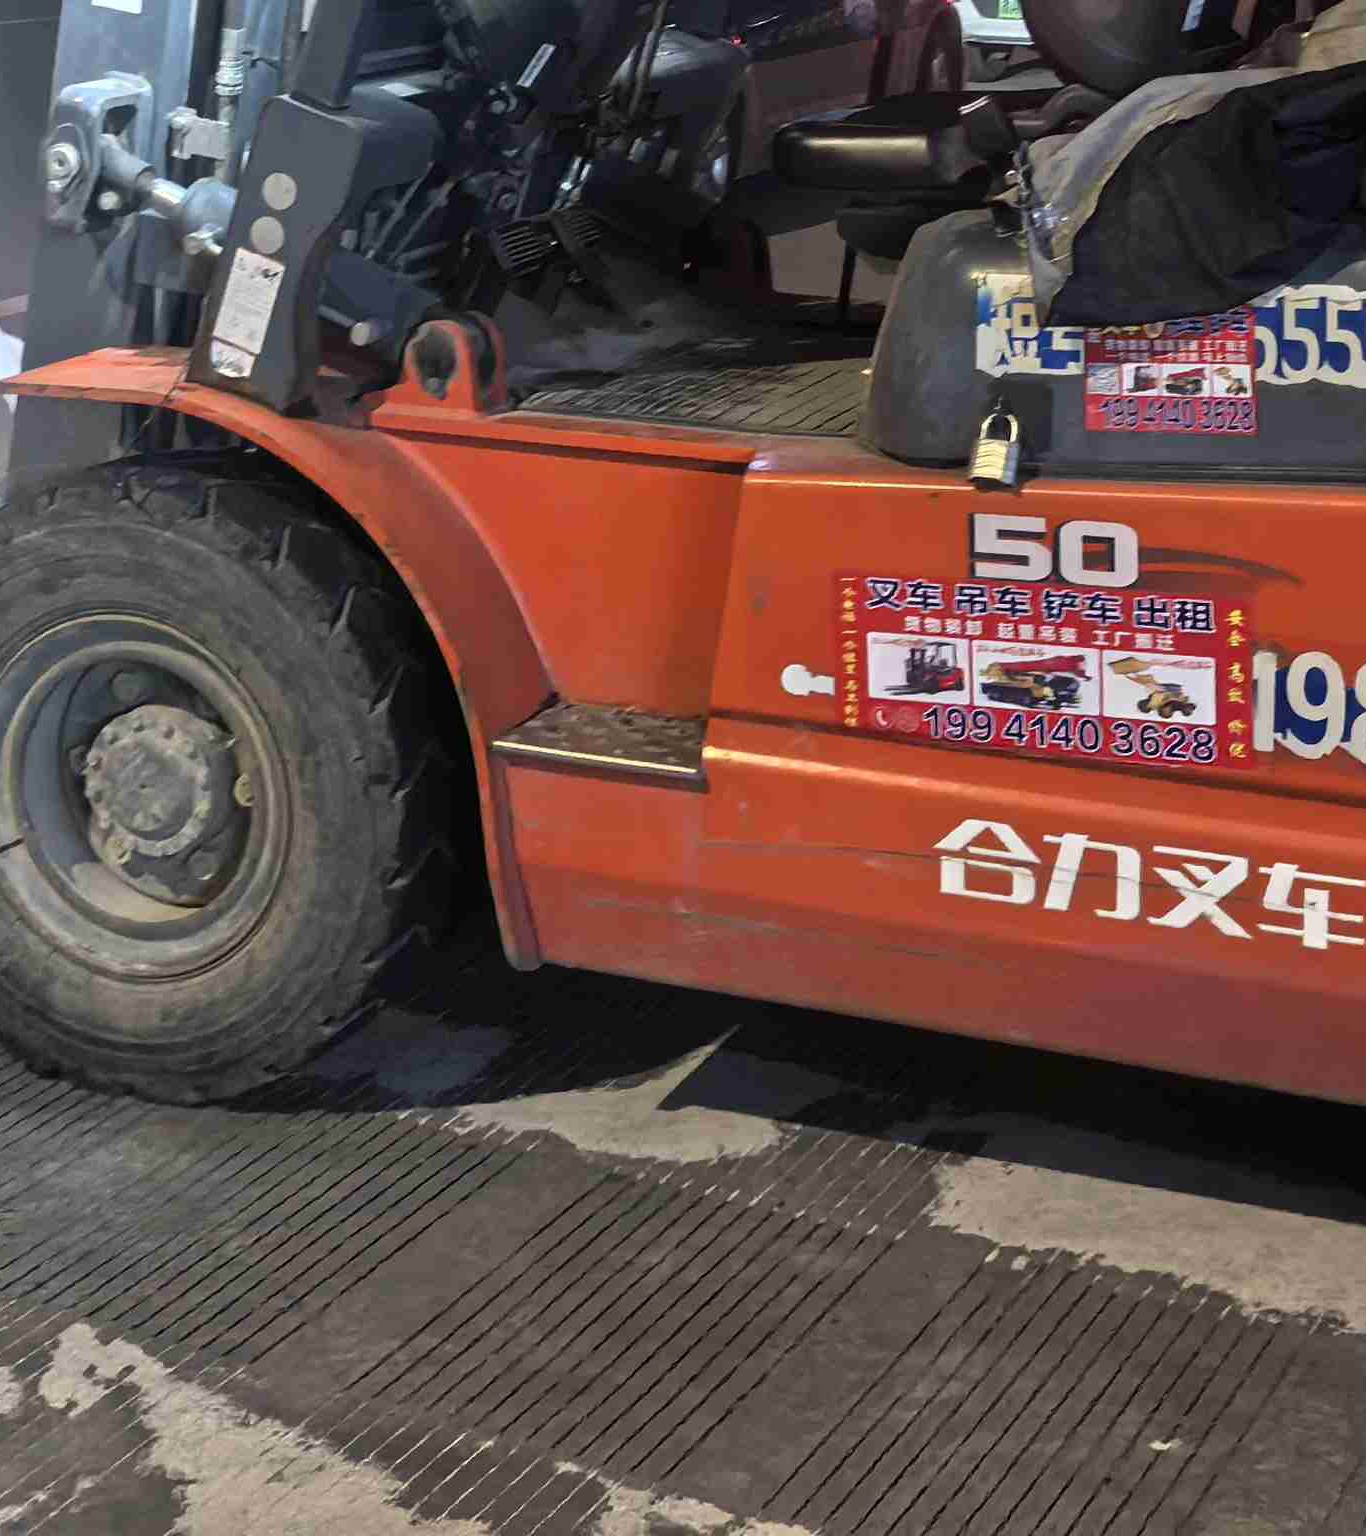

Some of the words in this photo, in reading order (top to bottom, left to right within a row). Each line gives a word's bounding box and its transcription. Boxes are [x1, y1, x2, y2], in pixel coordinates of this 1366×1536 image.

[970, 512, 1141, 588] 50
[864, 576, 945, 613] 叉车
[953, 582, 1035, 620] 吊车
[1041, 587, 1125, 626] 铲车
[1132, 595, 1217, 634] 出租
[1224, 609, 1247, 648] 安全
[922, 704, 996, 744] 199
[1002, 710, 1104, 754] 4140
[1108, 720, 1218, 764] 3628
